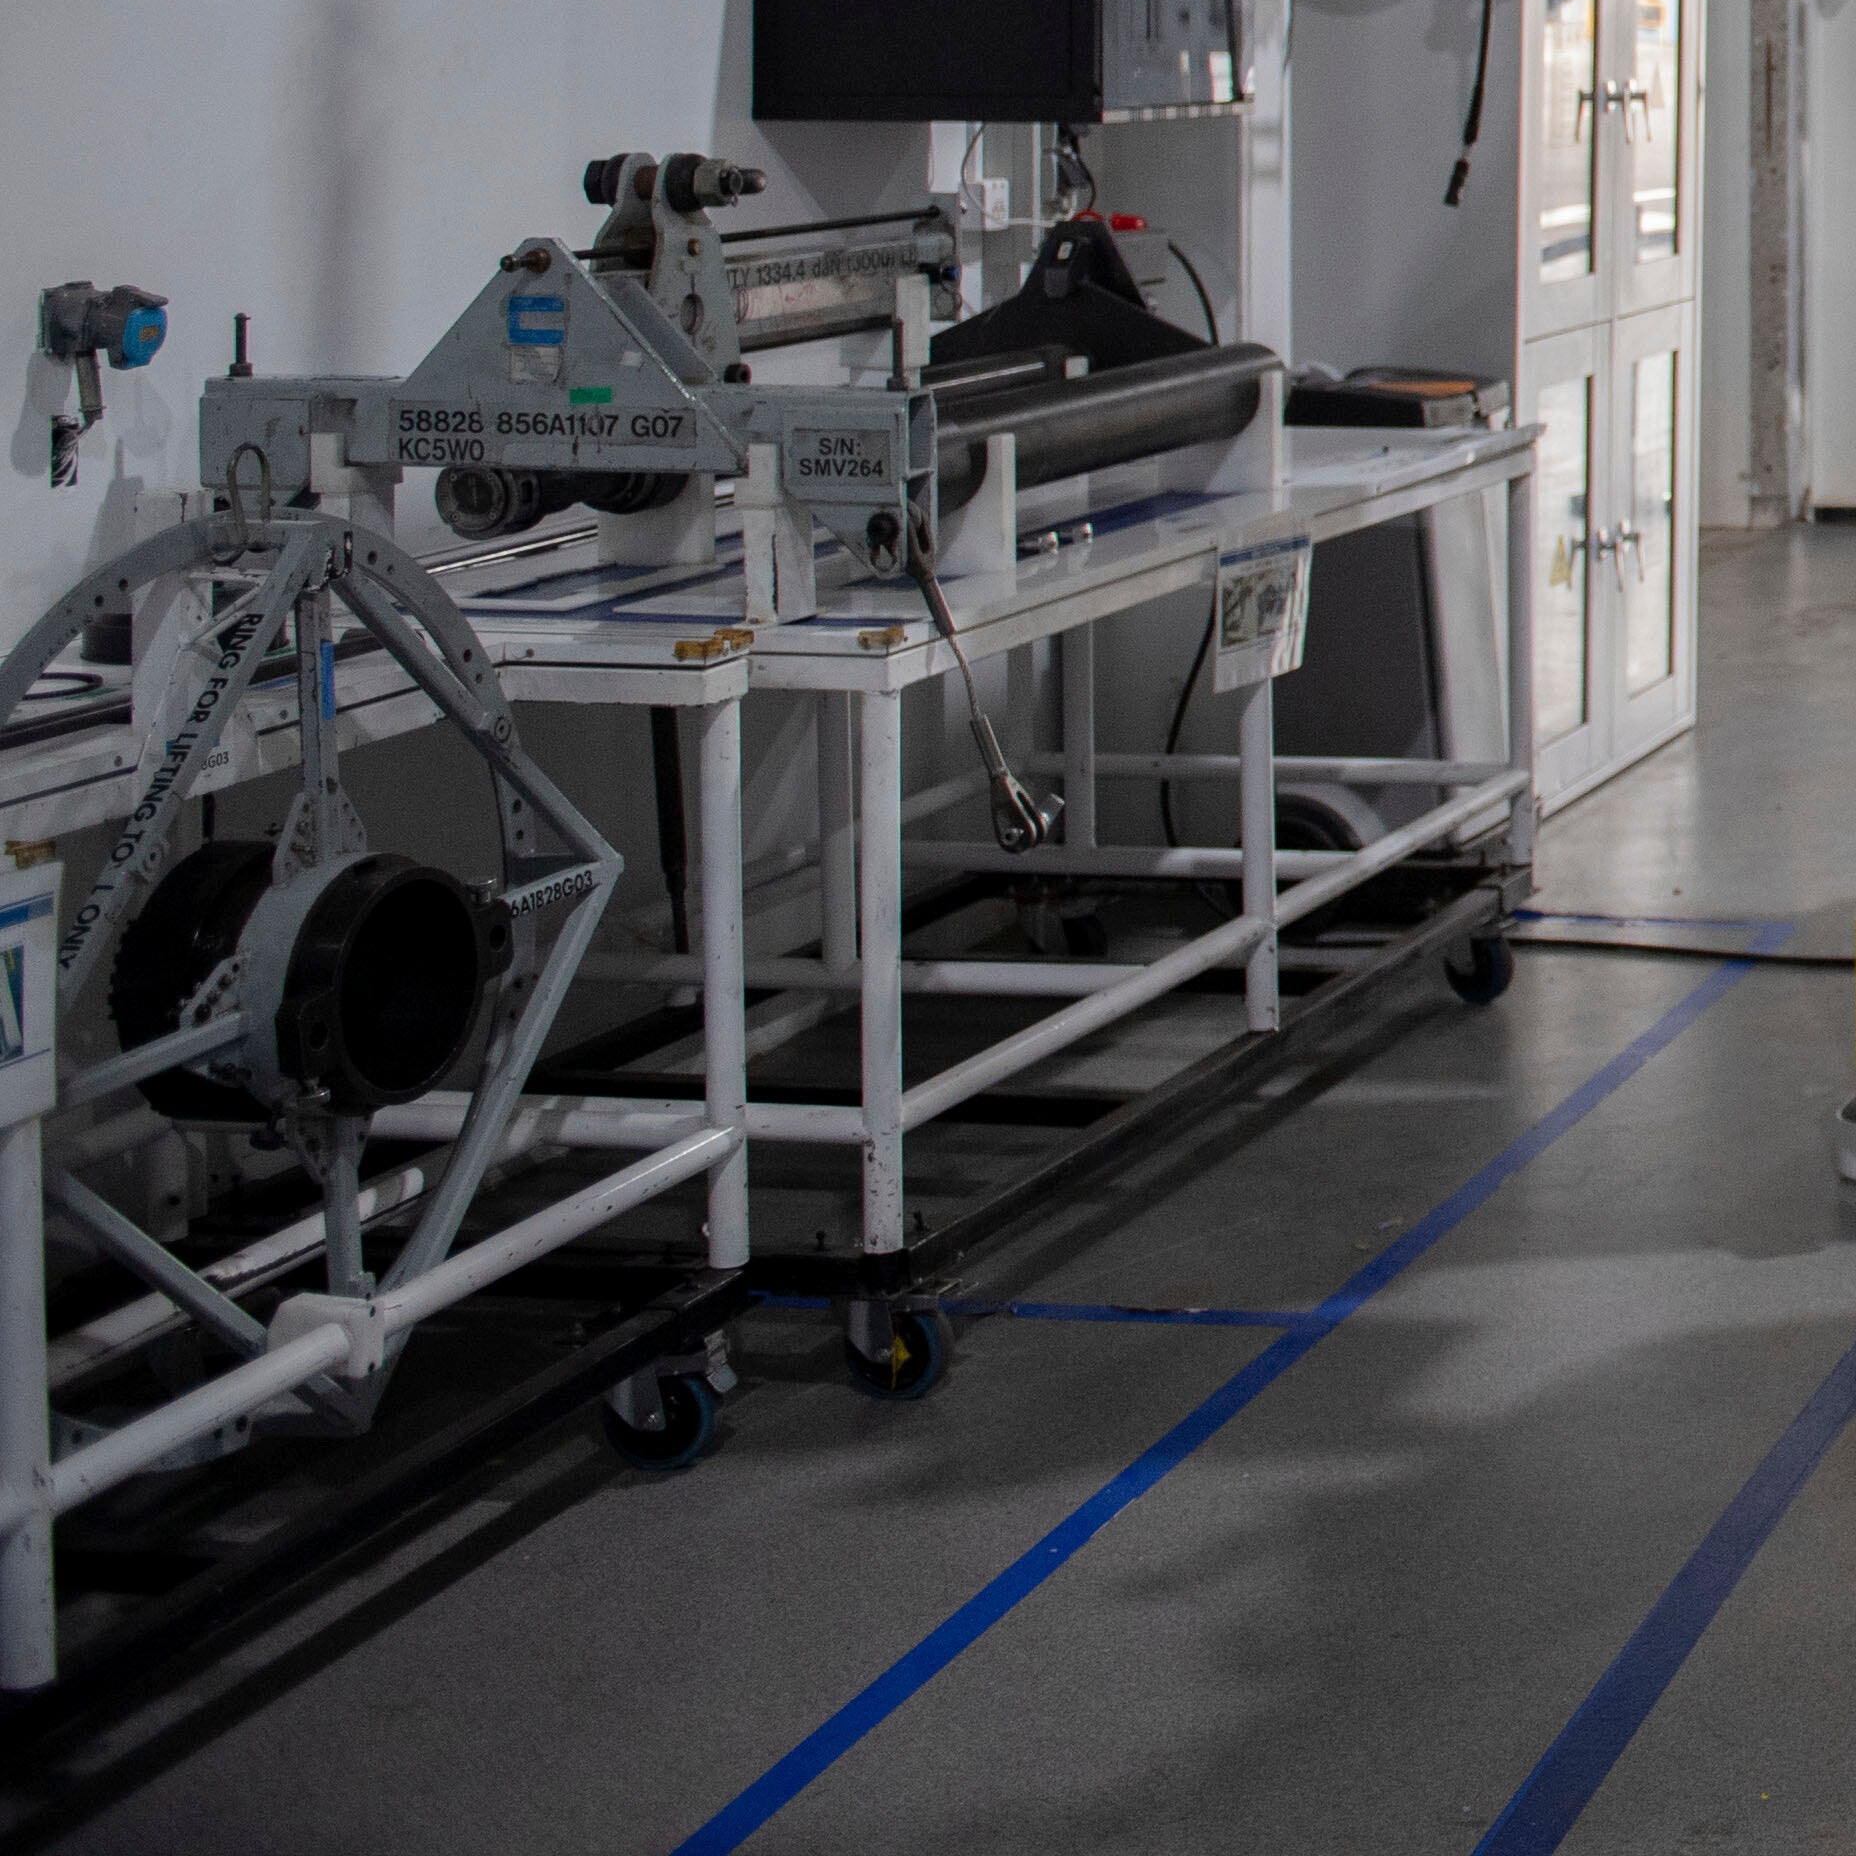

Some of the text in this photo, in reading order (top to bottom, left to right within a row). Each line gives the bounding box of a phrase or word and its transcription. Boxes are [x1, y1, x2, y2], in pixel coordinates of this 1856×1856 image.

[757, 259, 806, 286] 1334.4
[399, 409, 484, 434] 58828
[818, 437, 861, 456] S/N:
[799, 457, 884, 478] SMV264
[57, 613, 265, 971] RING FOR LIFTING TOL ONLY
